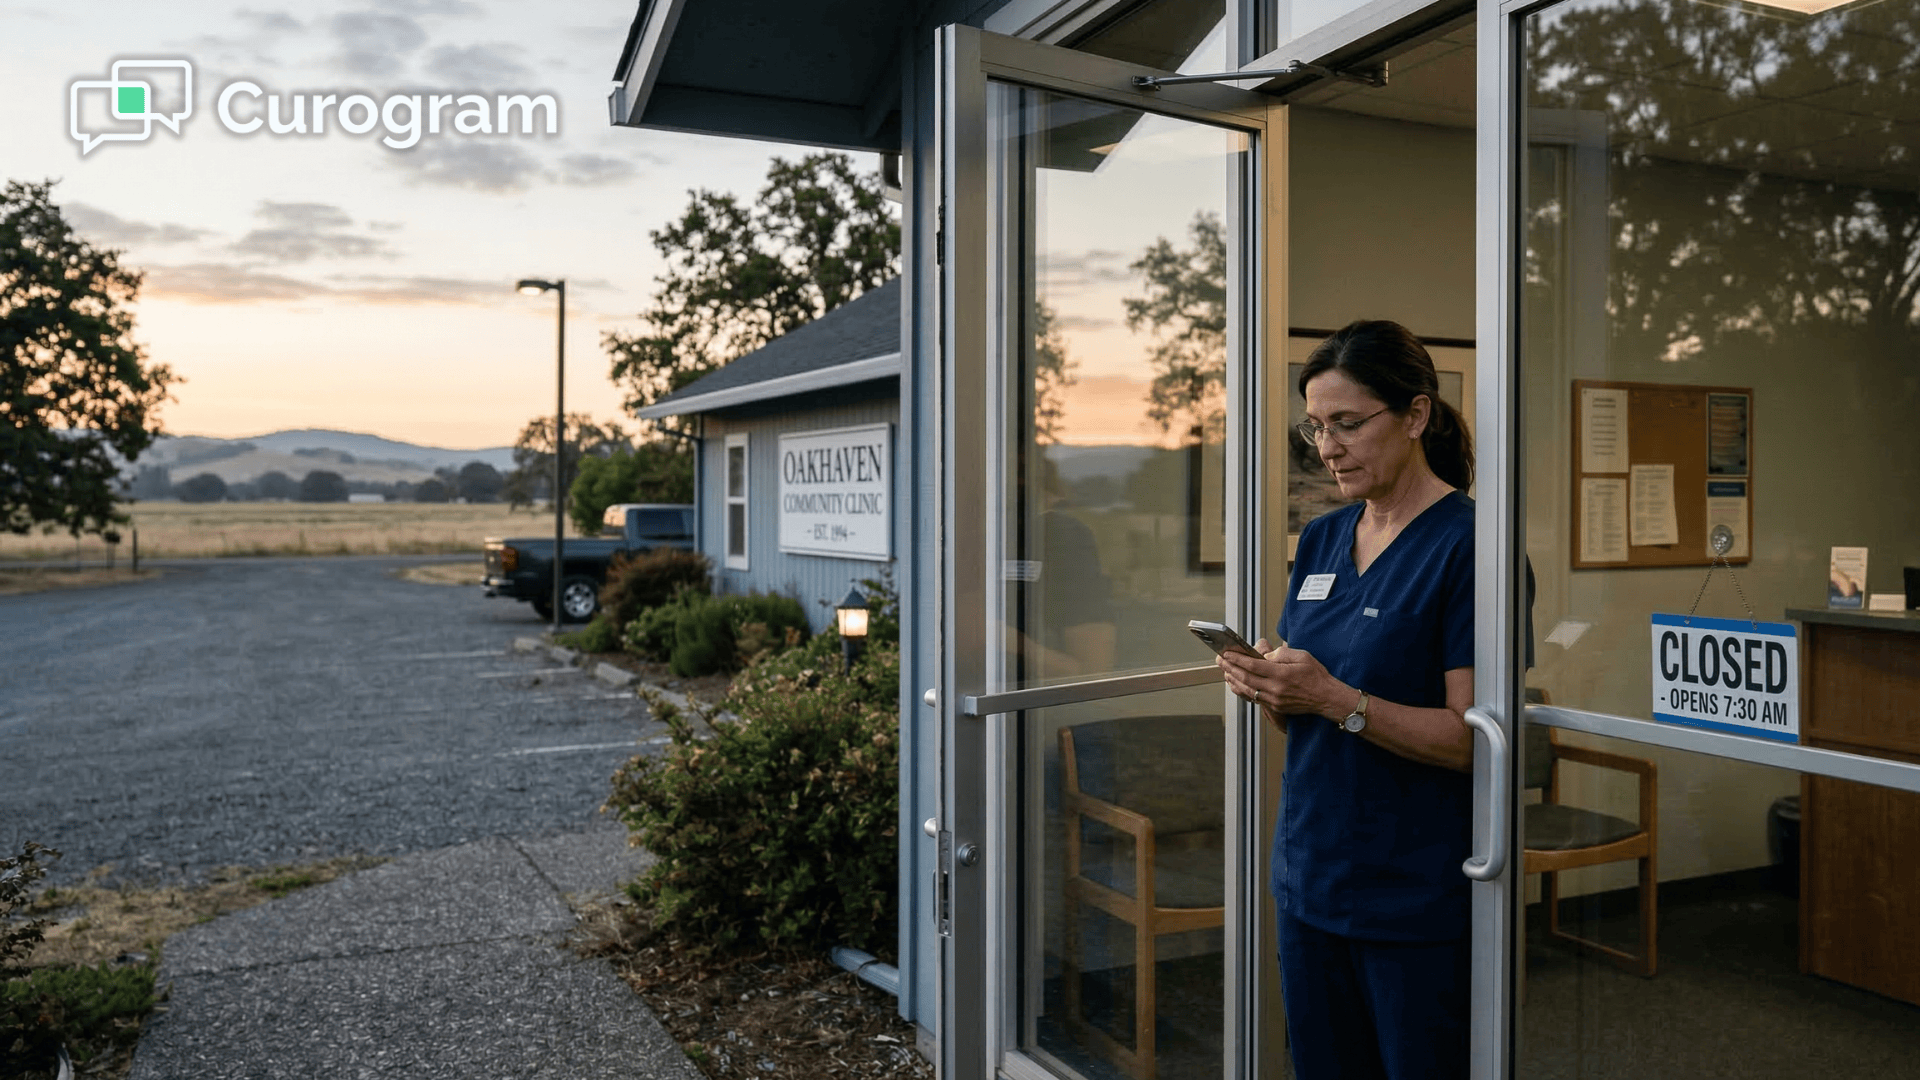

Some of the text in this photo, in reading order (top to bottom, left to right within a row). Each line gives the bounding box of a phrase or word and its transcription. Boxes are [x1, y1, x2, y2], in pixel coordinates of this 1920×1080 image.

[784, 444, 882, 484] OAKHAVEN
[784, 493, 882, 514] COMMUNITY CLINIC
[1660, 630, 1787, 694] CLOSED
[1670, 688, 1718, 715] OPENS
[1724, 695, 1757, 721] 7:30
[1762, 701, 1787, 726] AM
